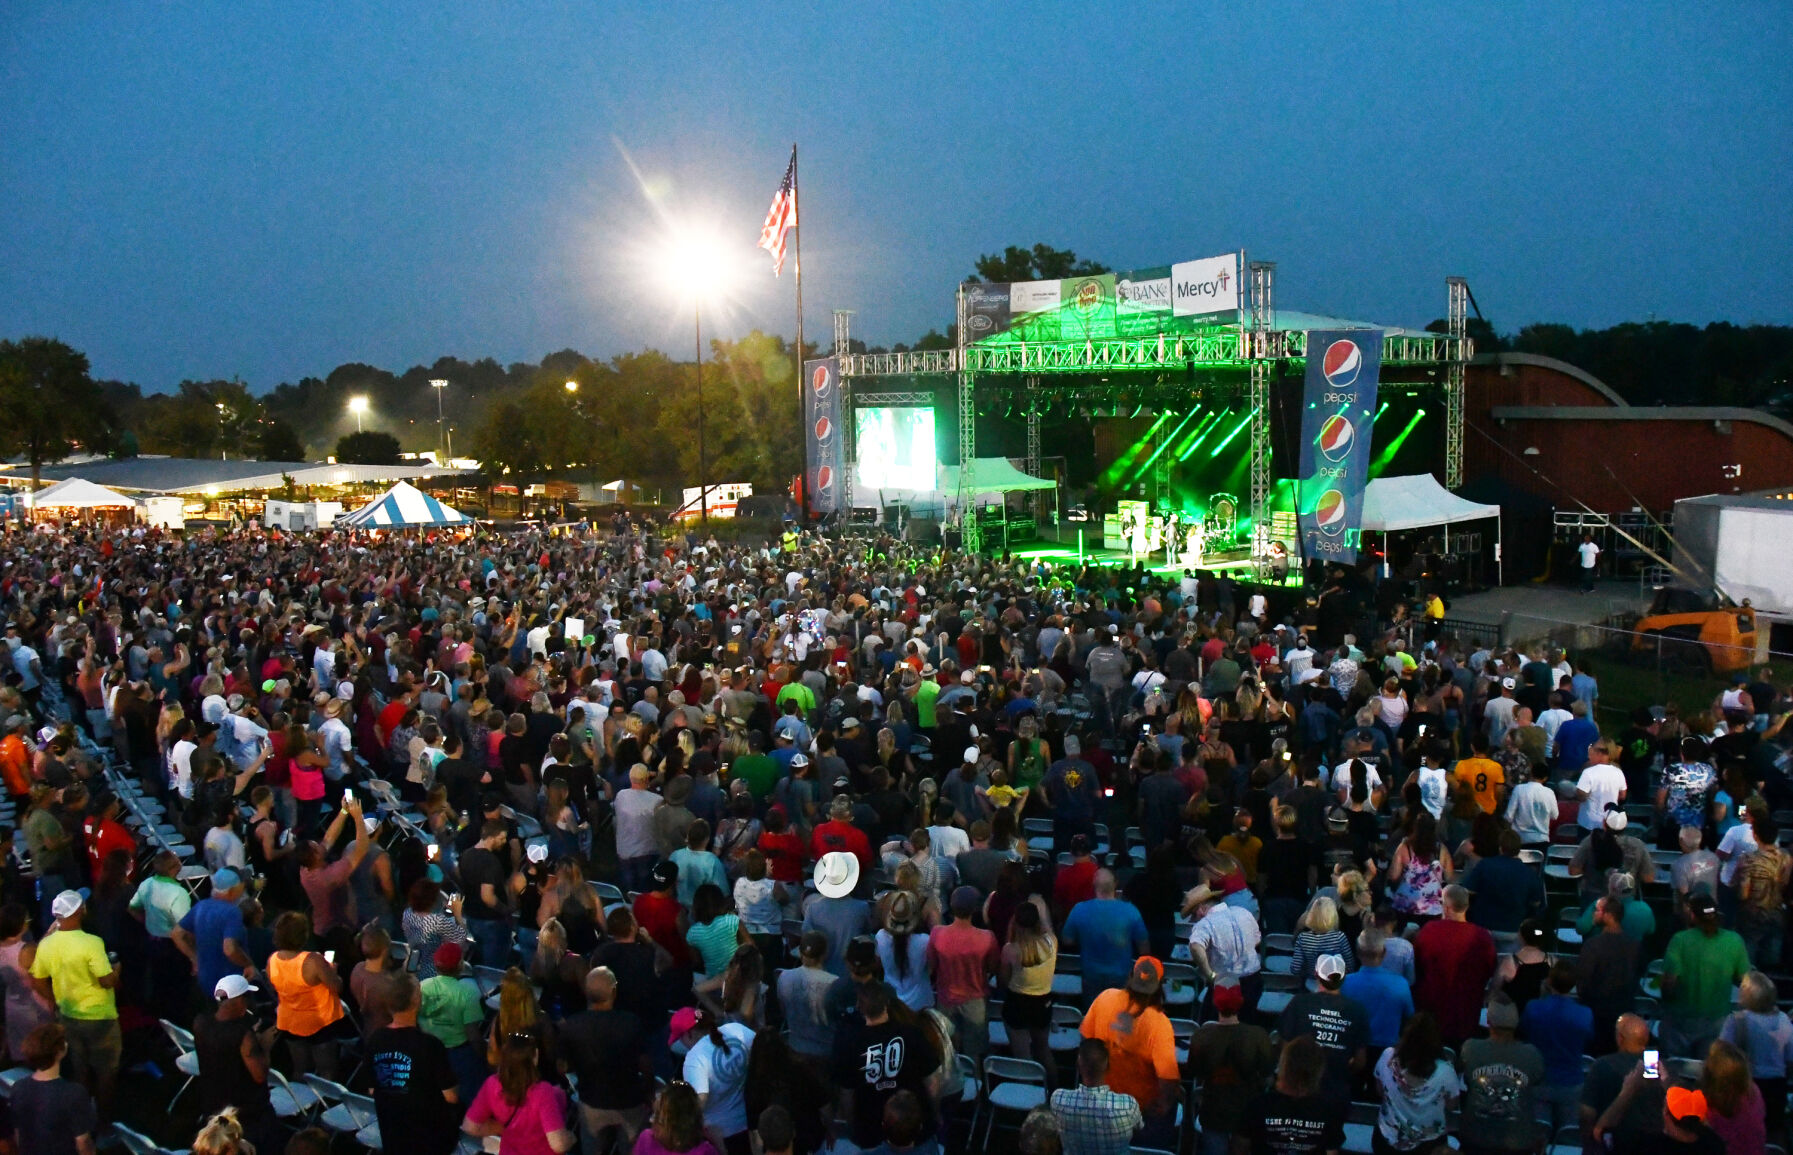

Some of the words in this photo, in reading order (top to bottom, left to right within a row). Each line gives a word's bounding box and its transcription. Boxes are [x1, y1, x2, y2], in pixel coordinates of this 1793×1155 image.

[1133, 281, 1166, 302] BANK
[1177, 281, 1219, 298] Mercy
[1323, 391, 1358, 405] pepsi
[1315, 540, 1344, 555] pepsi
[1475, 773, 1488, 793] 8
[1308, 1014, 1352, 1026] TECHNOLOGY
[1320, 1008, 1342, 1018] DIESEL
[1316, 1030, 1338, 1042] 2021
[863, 1036, 905, 1084] 50
[1292, 1119, 1304, 1127] PIG
[1305, 1120, 1326, 1129] ROAST
